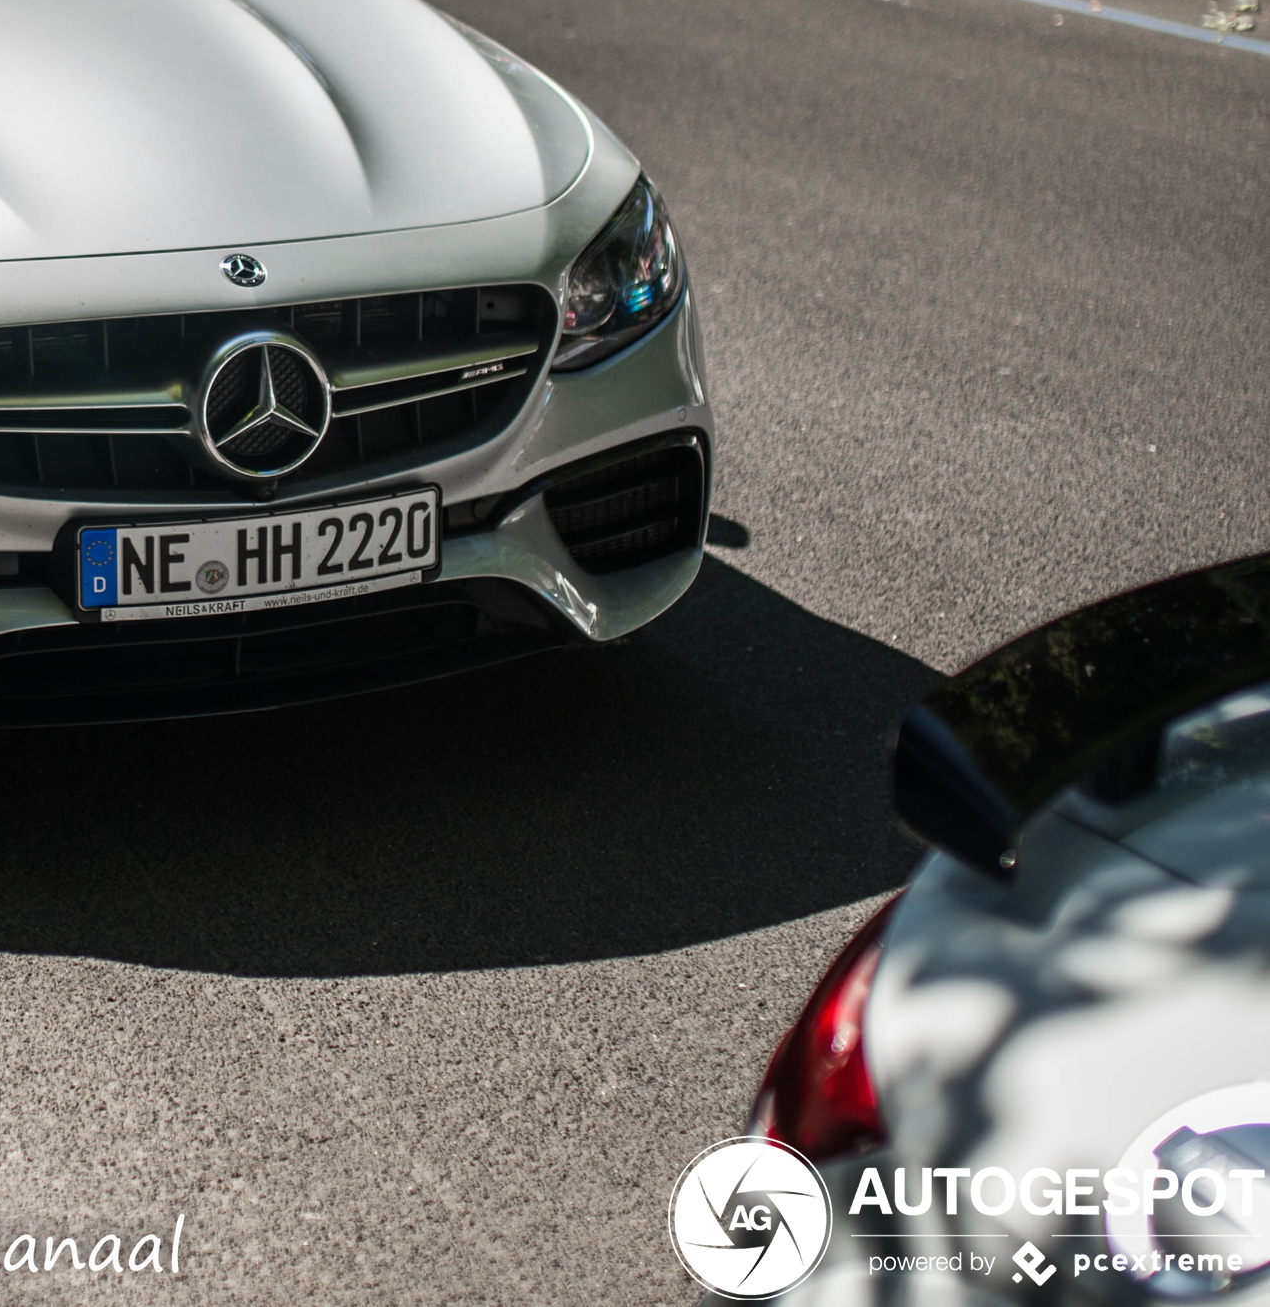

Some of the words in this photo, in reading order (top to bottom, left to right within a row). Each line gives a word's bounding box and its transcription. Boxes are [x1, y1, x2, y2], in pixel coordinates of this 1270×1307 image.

[122, 533, 192, 595] NE
[237, 522, 302, 586] HH
[317, 501, 431, 576] 2220
[93, 576, 106, 593] D
[264, 583, 369, 608] www.neils-und-kraft.de
